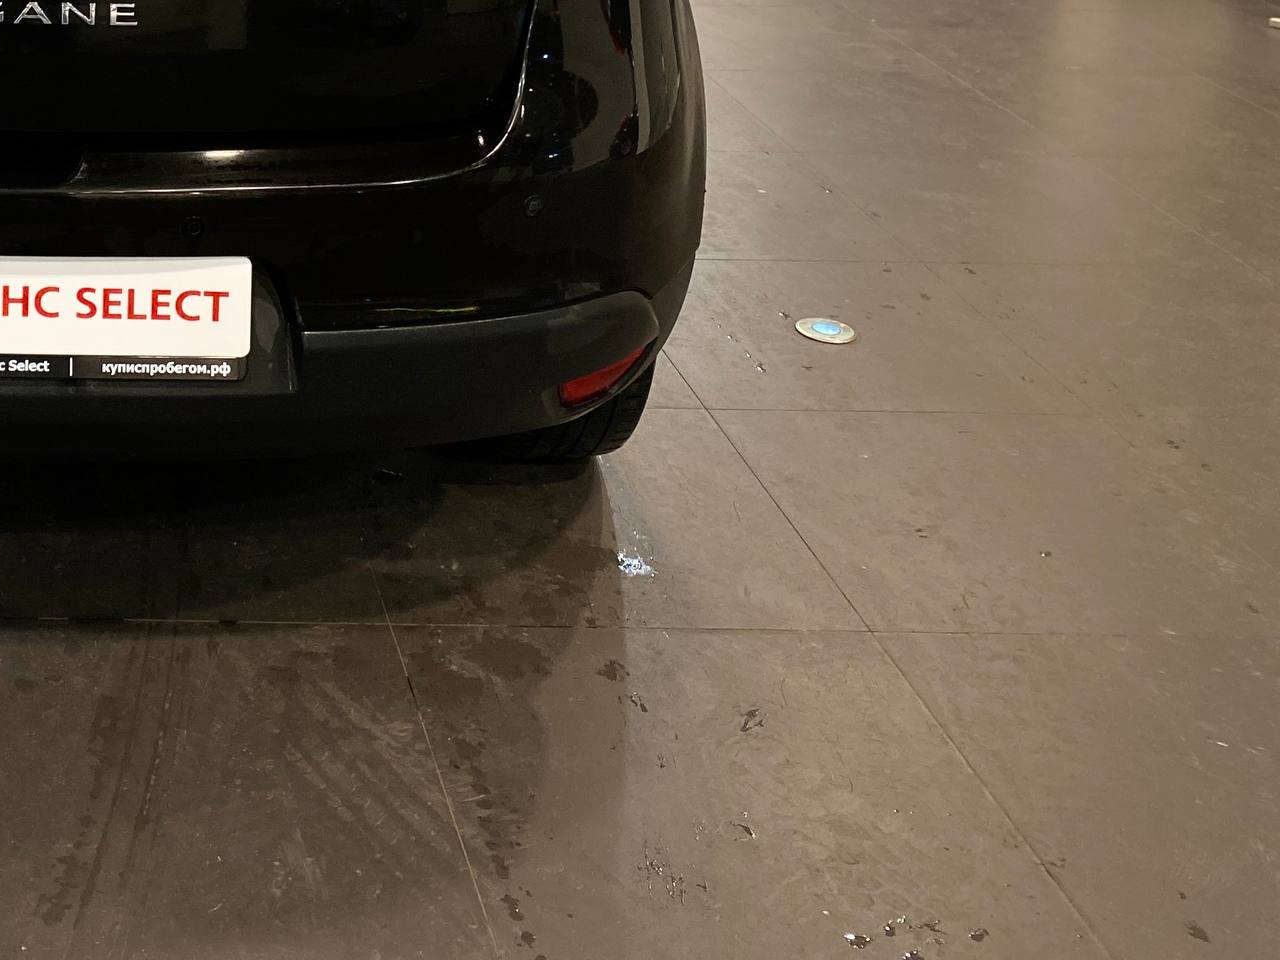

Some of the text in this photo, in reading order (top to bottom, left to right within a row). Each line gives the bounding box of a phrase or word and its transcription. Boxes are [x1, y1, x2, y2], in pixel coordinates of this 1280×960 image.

[75, 287, 230, 322] SELECT
[8, 360, 50, 372] Select
[102, 361, 232, 377] куписпробегом.рф
